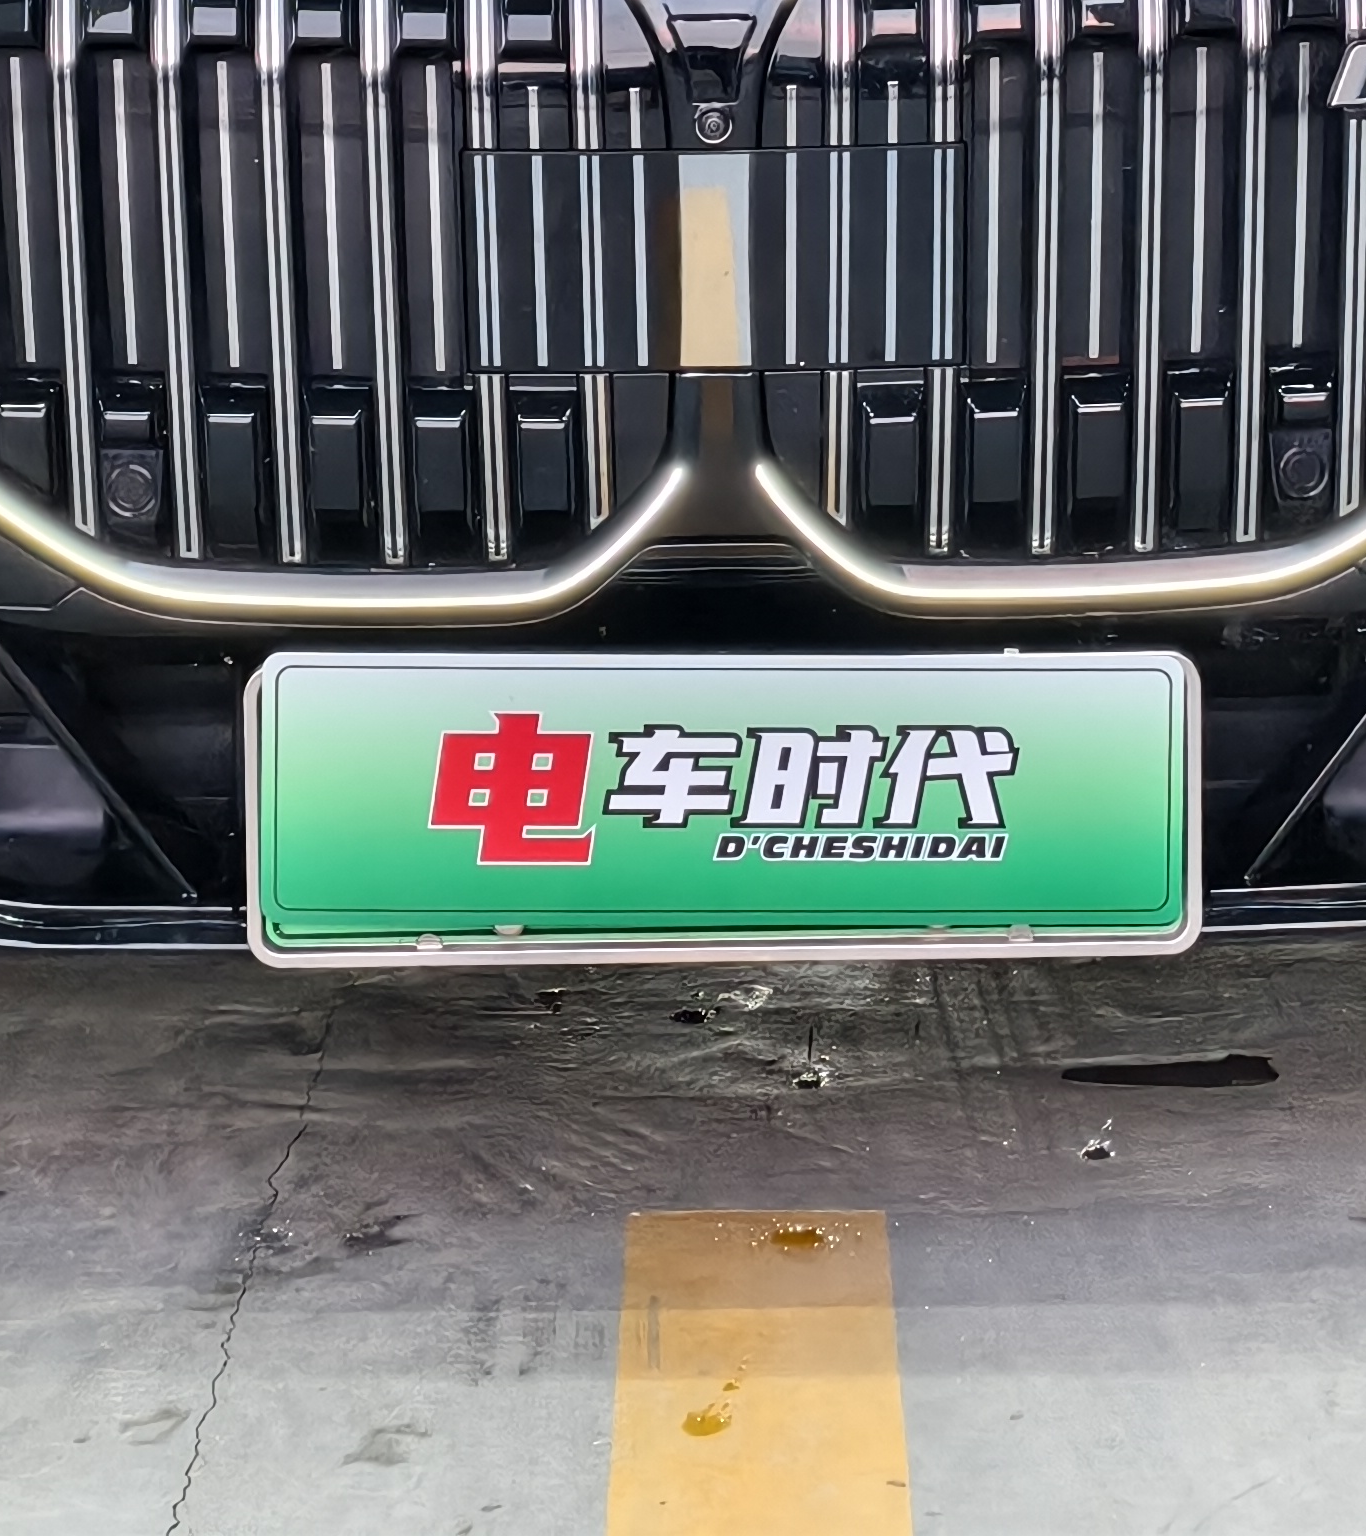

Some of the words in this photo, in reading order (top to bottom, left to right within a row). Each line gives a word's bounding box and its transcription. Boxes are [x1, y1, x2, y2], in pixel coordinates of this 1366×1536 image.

[428, 711, 1019, 866] 电车时代
[714, 833, 1008, 861] D'CHESHIDAI
